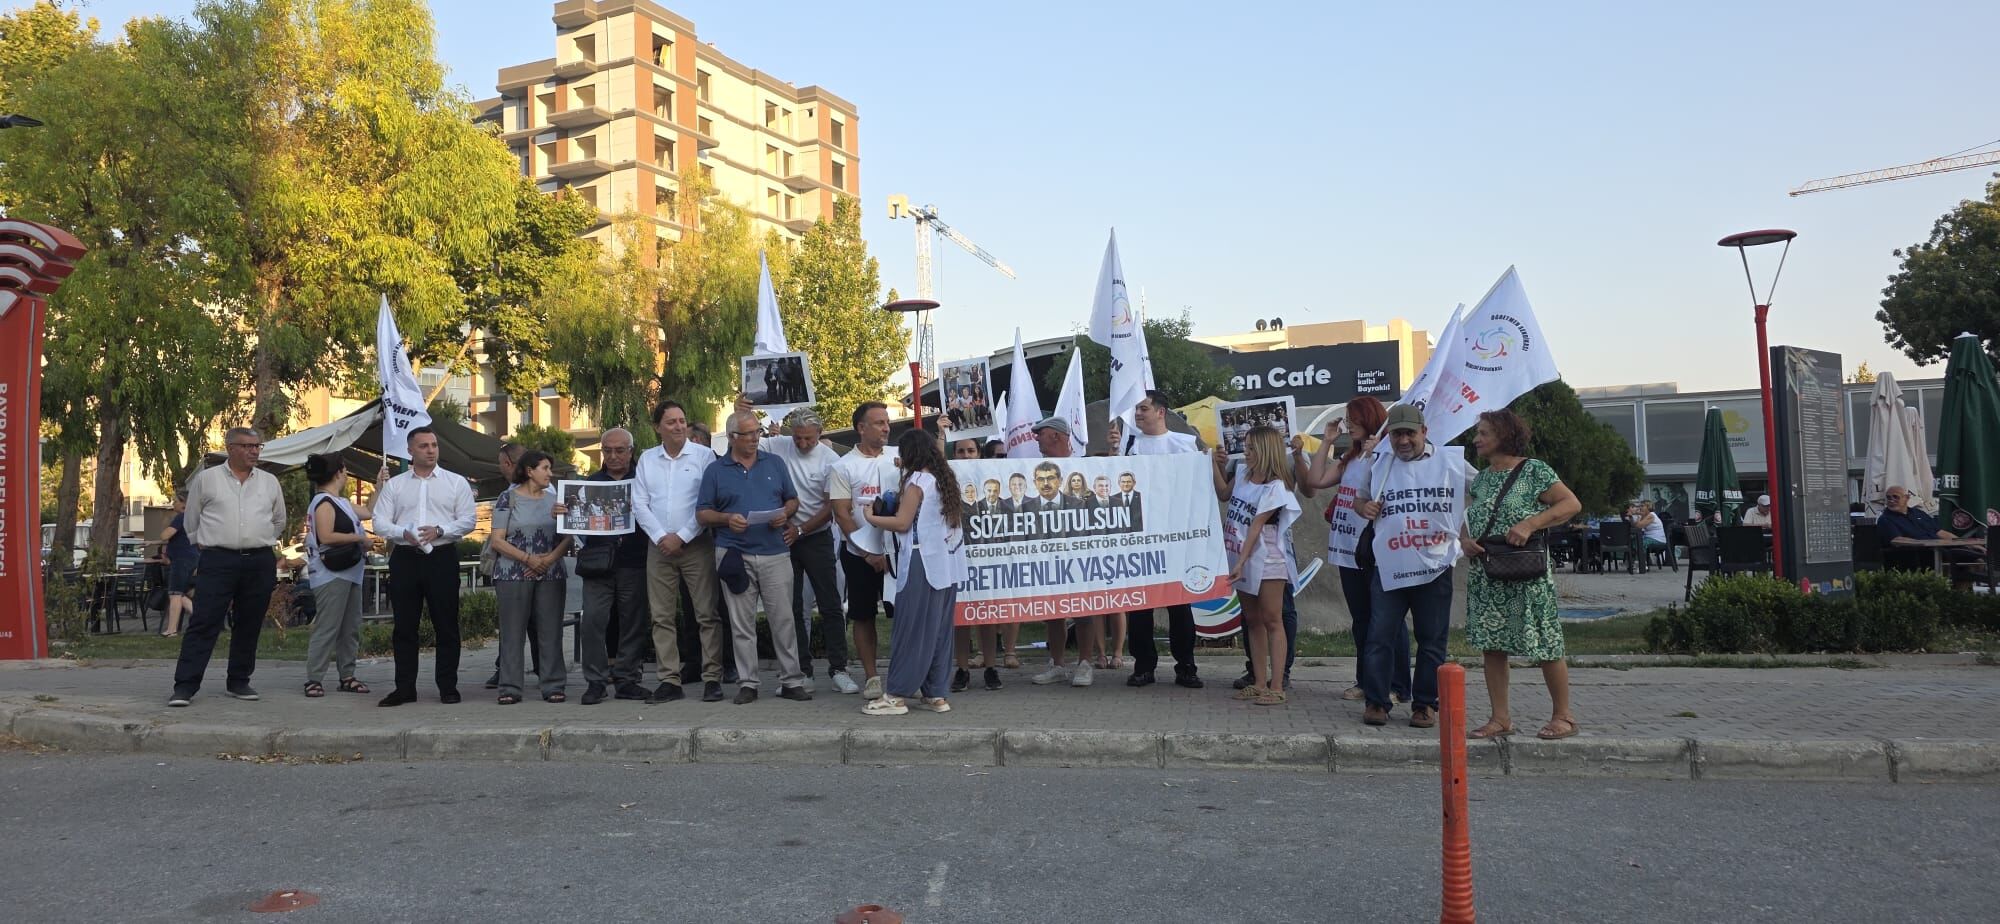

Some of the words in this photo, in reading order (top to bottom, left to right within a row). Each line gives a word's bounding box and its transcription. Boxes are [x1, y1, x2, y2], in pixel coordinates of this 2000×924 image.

[1230, 374, 1261, 391] en
[1267, 364, 1332, 389] Cafe
[1357, 384, 1391, 393] Bayraklı!
[1335, 508, 1348, 521] İLE
[1381, 500, 1453, 519] SENDİKASI
[969, 510, 1037, 540] SÖZLER
[1038, 506, 1132, 535] TUTULSUN
[1331, 520, 1356, 536] ÜÇLÜ!
[1406, 516, 1429, 530] İLE
[965, 545, 1029, 559] AĞDURLARI
[1030, 544, 1039, 554] &
[1040, 541, 1070, 554] ÖZEL
[1071, 536, 1118, 552] SEKTÖR
[1119, 525, 1211, 547] ÖĞRETMENLERİ
[956, 555, 1075, 593] RETMENLİK
[1077, 549, 1167, 585] YAŞASIN!
[1392, 568, 1428, 580] ÖĞRETMEN
[964, 600, 1056, 621] ÖĞRETMEN
[1060, 591, 1147, 615] SENDİKASI
